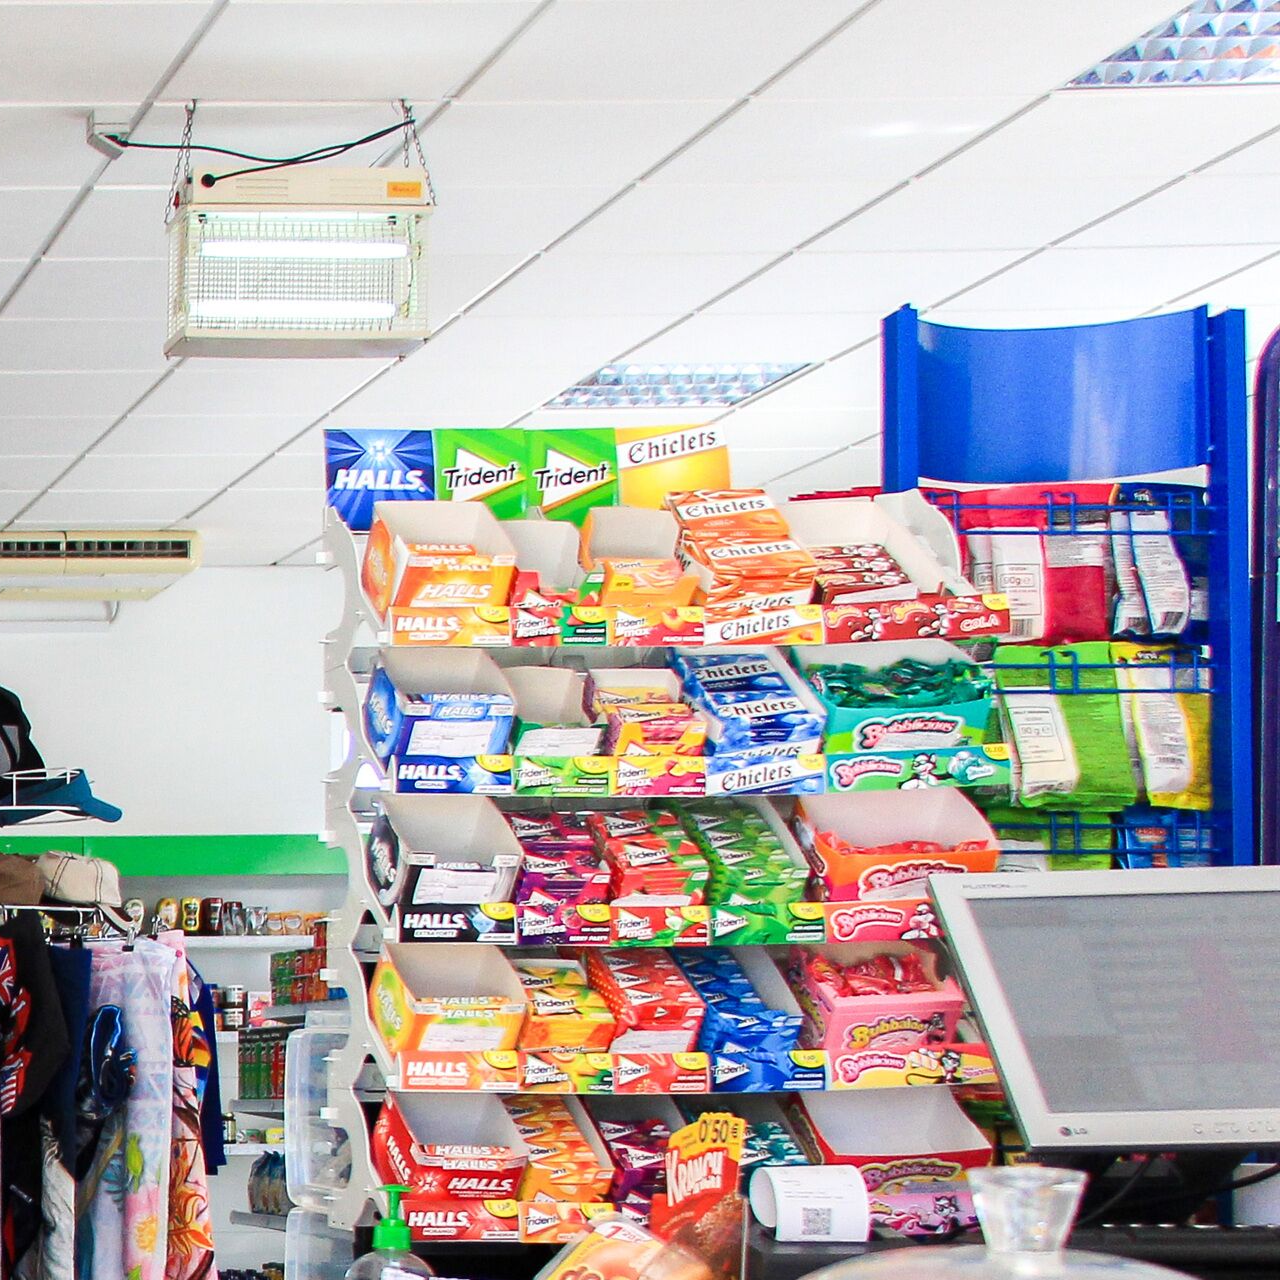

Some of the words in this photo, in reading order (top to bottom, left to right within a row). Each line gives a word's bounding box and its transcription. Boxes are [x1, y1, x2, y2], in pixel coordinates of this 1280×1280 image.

[629, 430, 716, 464] Chiclets
[443, 462, 518, 489] Trident
[535, 462, 609, 489] Trident
[685, 500, 766, 518] Chiclets
[711, 542, 792, 558] Chiclets
[514, 618, 549, 629] Trident
[614, 617, 647, 629] Trident
[720, 614, 790, 640] Chiclets
[960, 615, 1000, 632] COLA
[718, 700, 797, 718] Chiclets
[860, 718, 957, 748] Bubblicious
[515, 768, 550, 778] Trident
[722, 764, 792, 791] Chiclets
[835, 760, 902, 786] Bubblicious
[518, 917, 553, 928] Trident
[615, 917, 650, 930] Trident
[711, 917, 746, 929] Trident
[837, 907, 903, 936] Bubblicious
[531, 998, 575, 1008] Trident
[523, 1065, 557, 1076] Trident
[615, 1065, 649, 1077] Trident
[713, 1065, 747, 1077] Trident
[841, 1053, 905, 1082] Bubblicious
[526, 1216, 557, 1226] Trident
